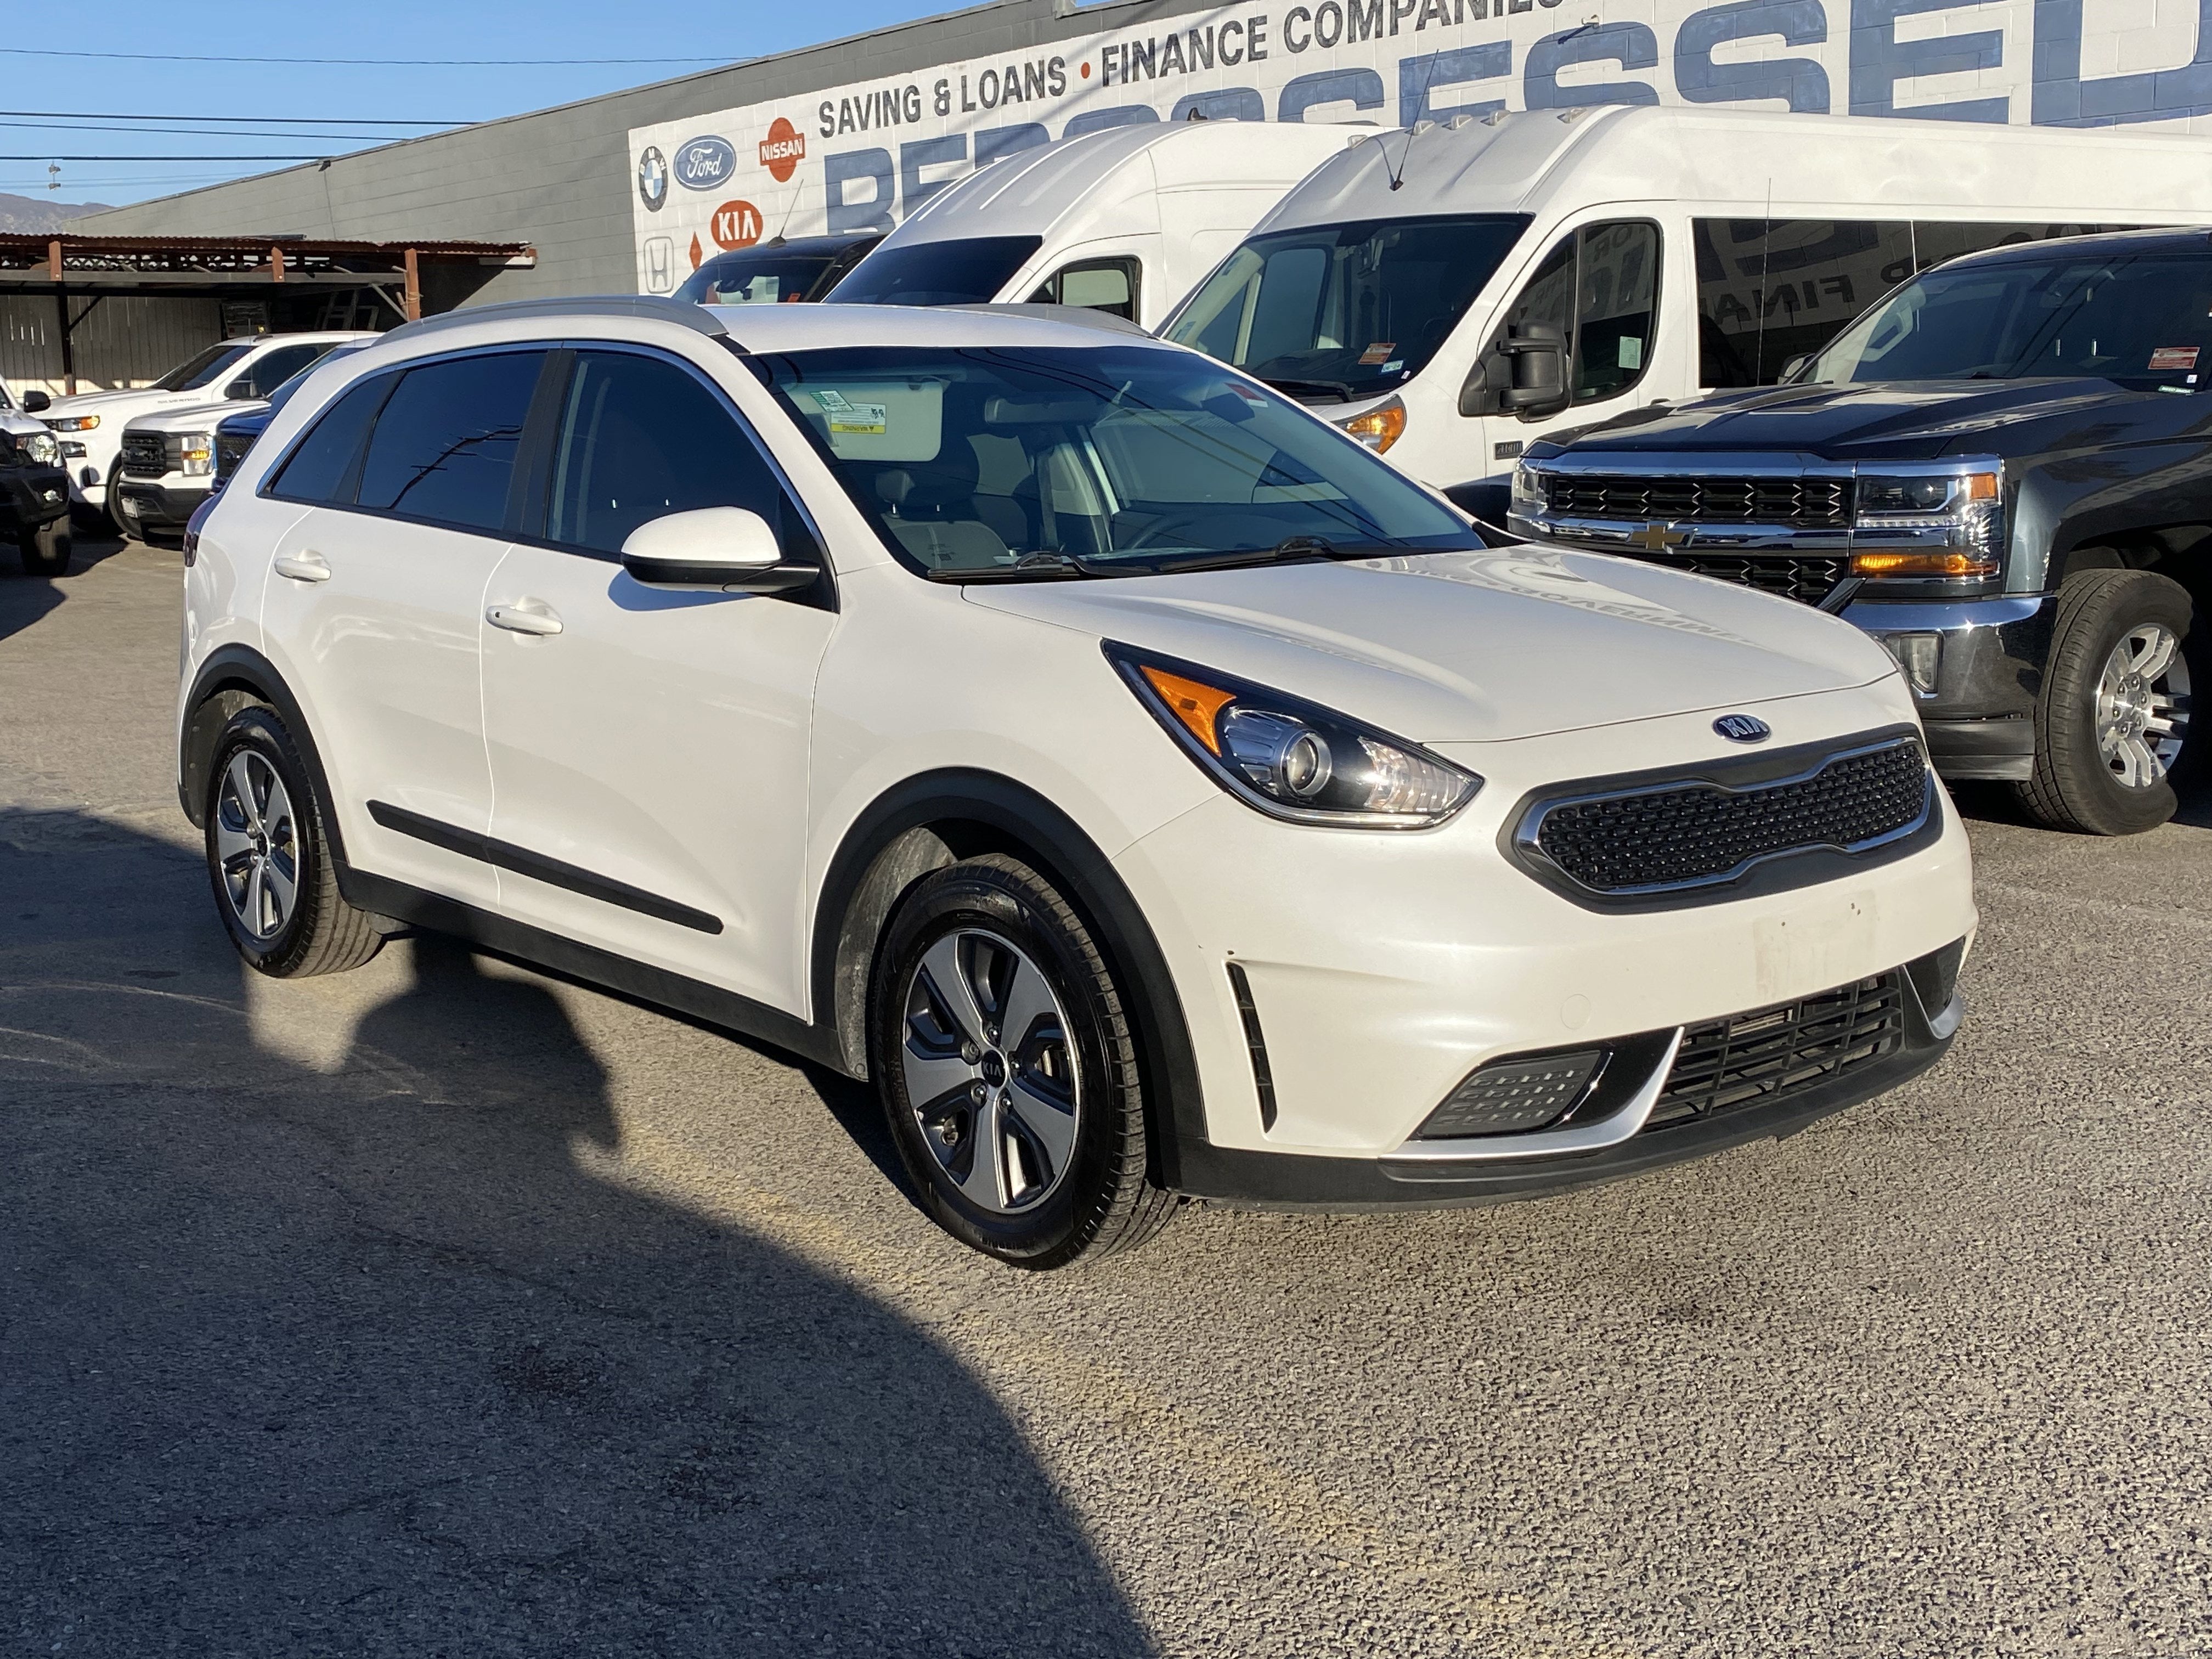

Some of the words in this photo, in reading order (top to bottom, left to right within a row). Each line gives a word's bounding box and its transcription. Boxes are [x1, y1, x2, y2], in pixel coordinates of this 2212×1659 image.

[819, 84, 921, 138] SAVING
[933, 78, 951, 117] &
[961, 56, 1066, 112] LOANS
[1102, 15, 1268, 87] FINANCE
[1284, 0, 1564, 54] COMPA
[686, 148, 723, 179] Ford
[761, 138, 804, 162] NISSAN
[718, 210, 758, 241] KIA
[1718, 716, 1769, 737] KIA
[983, 1062, 1002, 1077] KIA
